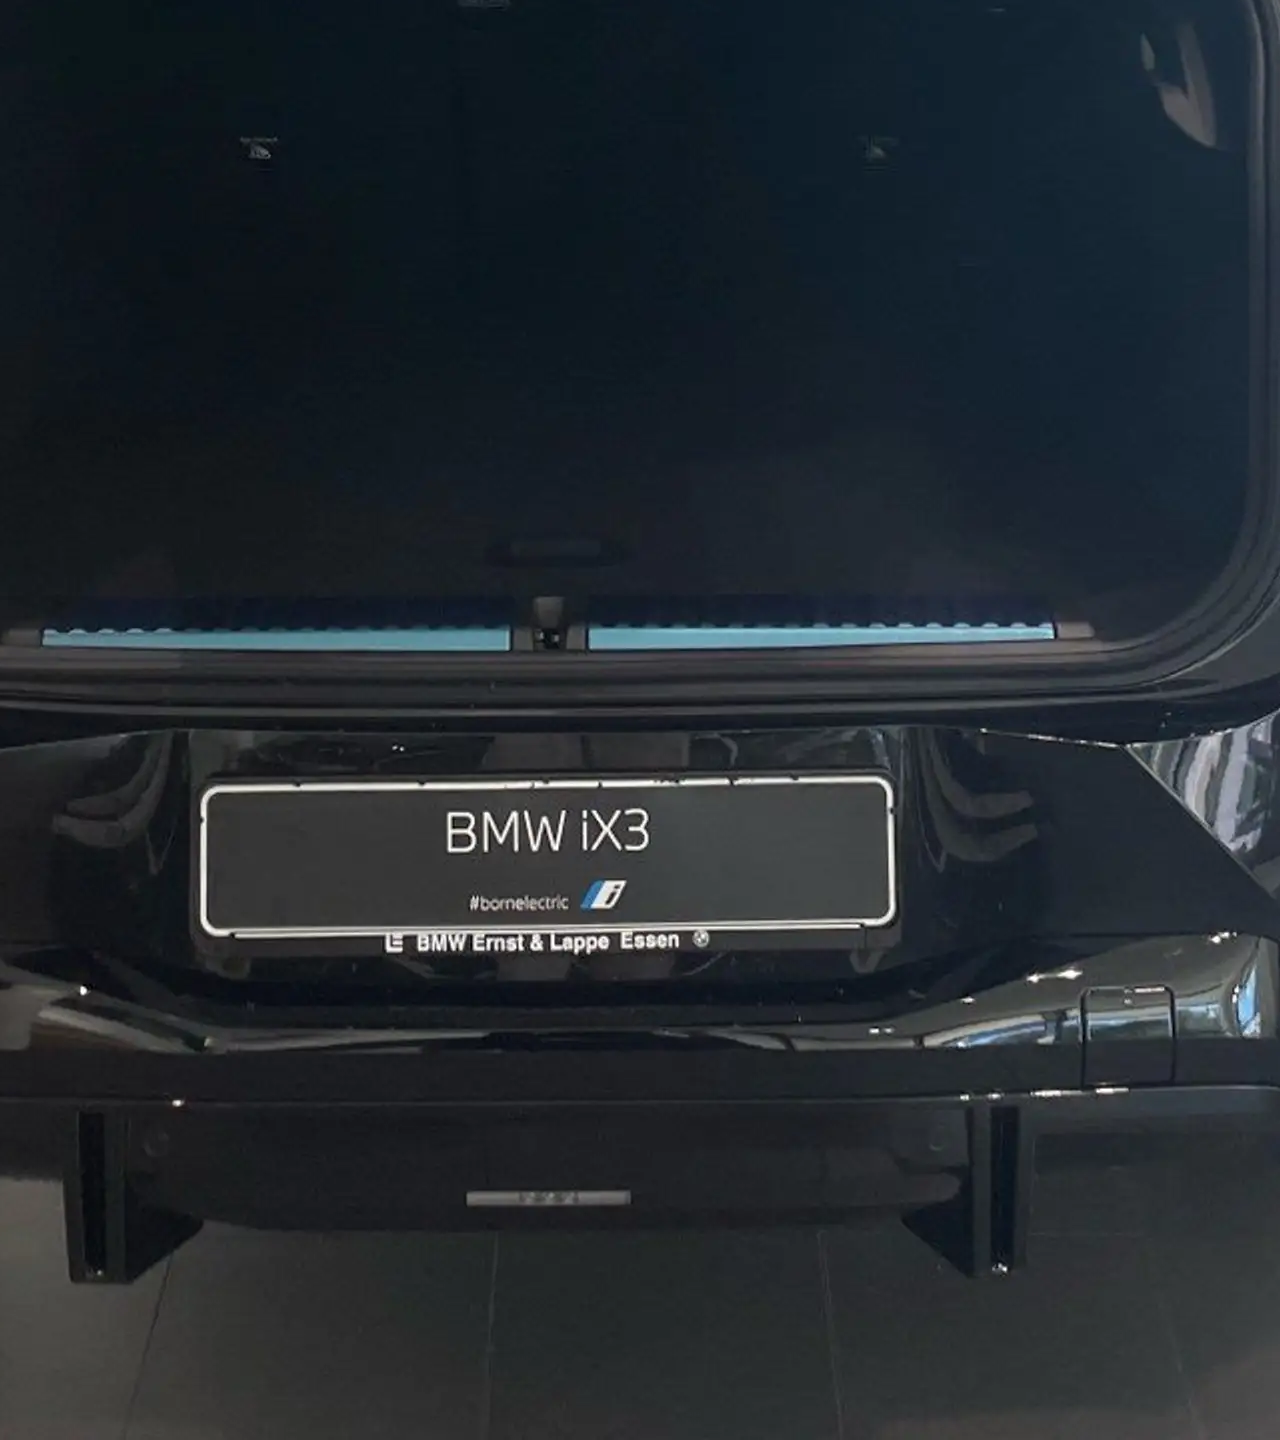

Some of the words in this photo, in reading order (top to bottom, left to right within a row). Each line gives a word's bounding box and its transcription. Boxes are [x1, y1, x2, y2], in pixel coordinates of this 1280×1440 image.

[446, 809, 567, 853] BMW
[581, 807, 651, 852] iX3
[469, 894, 570, 912] #bornelectric
[417, 933, 466, 952] BMW
[472, 933, 526, 952] Ernst
[529, 933, 544, 952] &
[550, 932, 610, 955] Lappe
[620, 931, 680, 950] Essen
